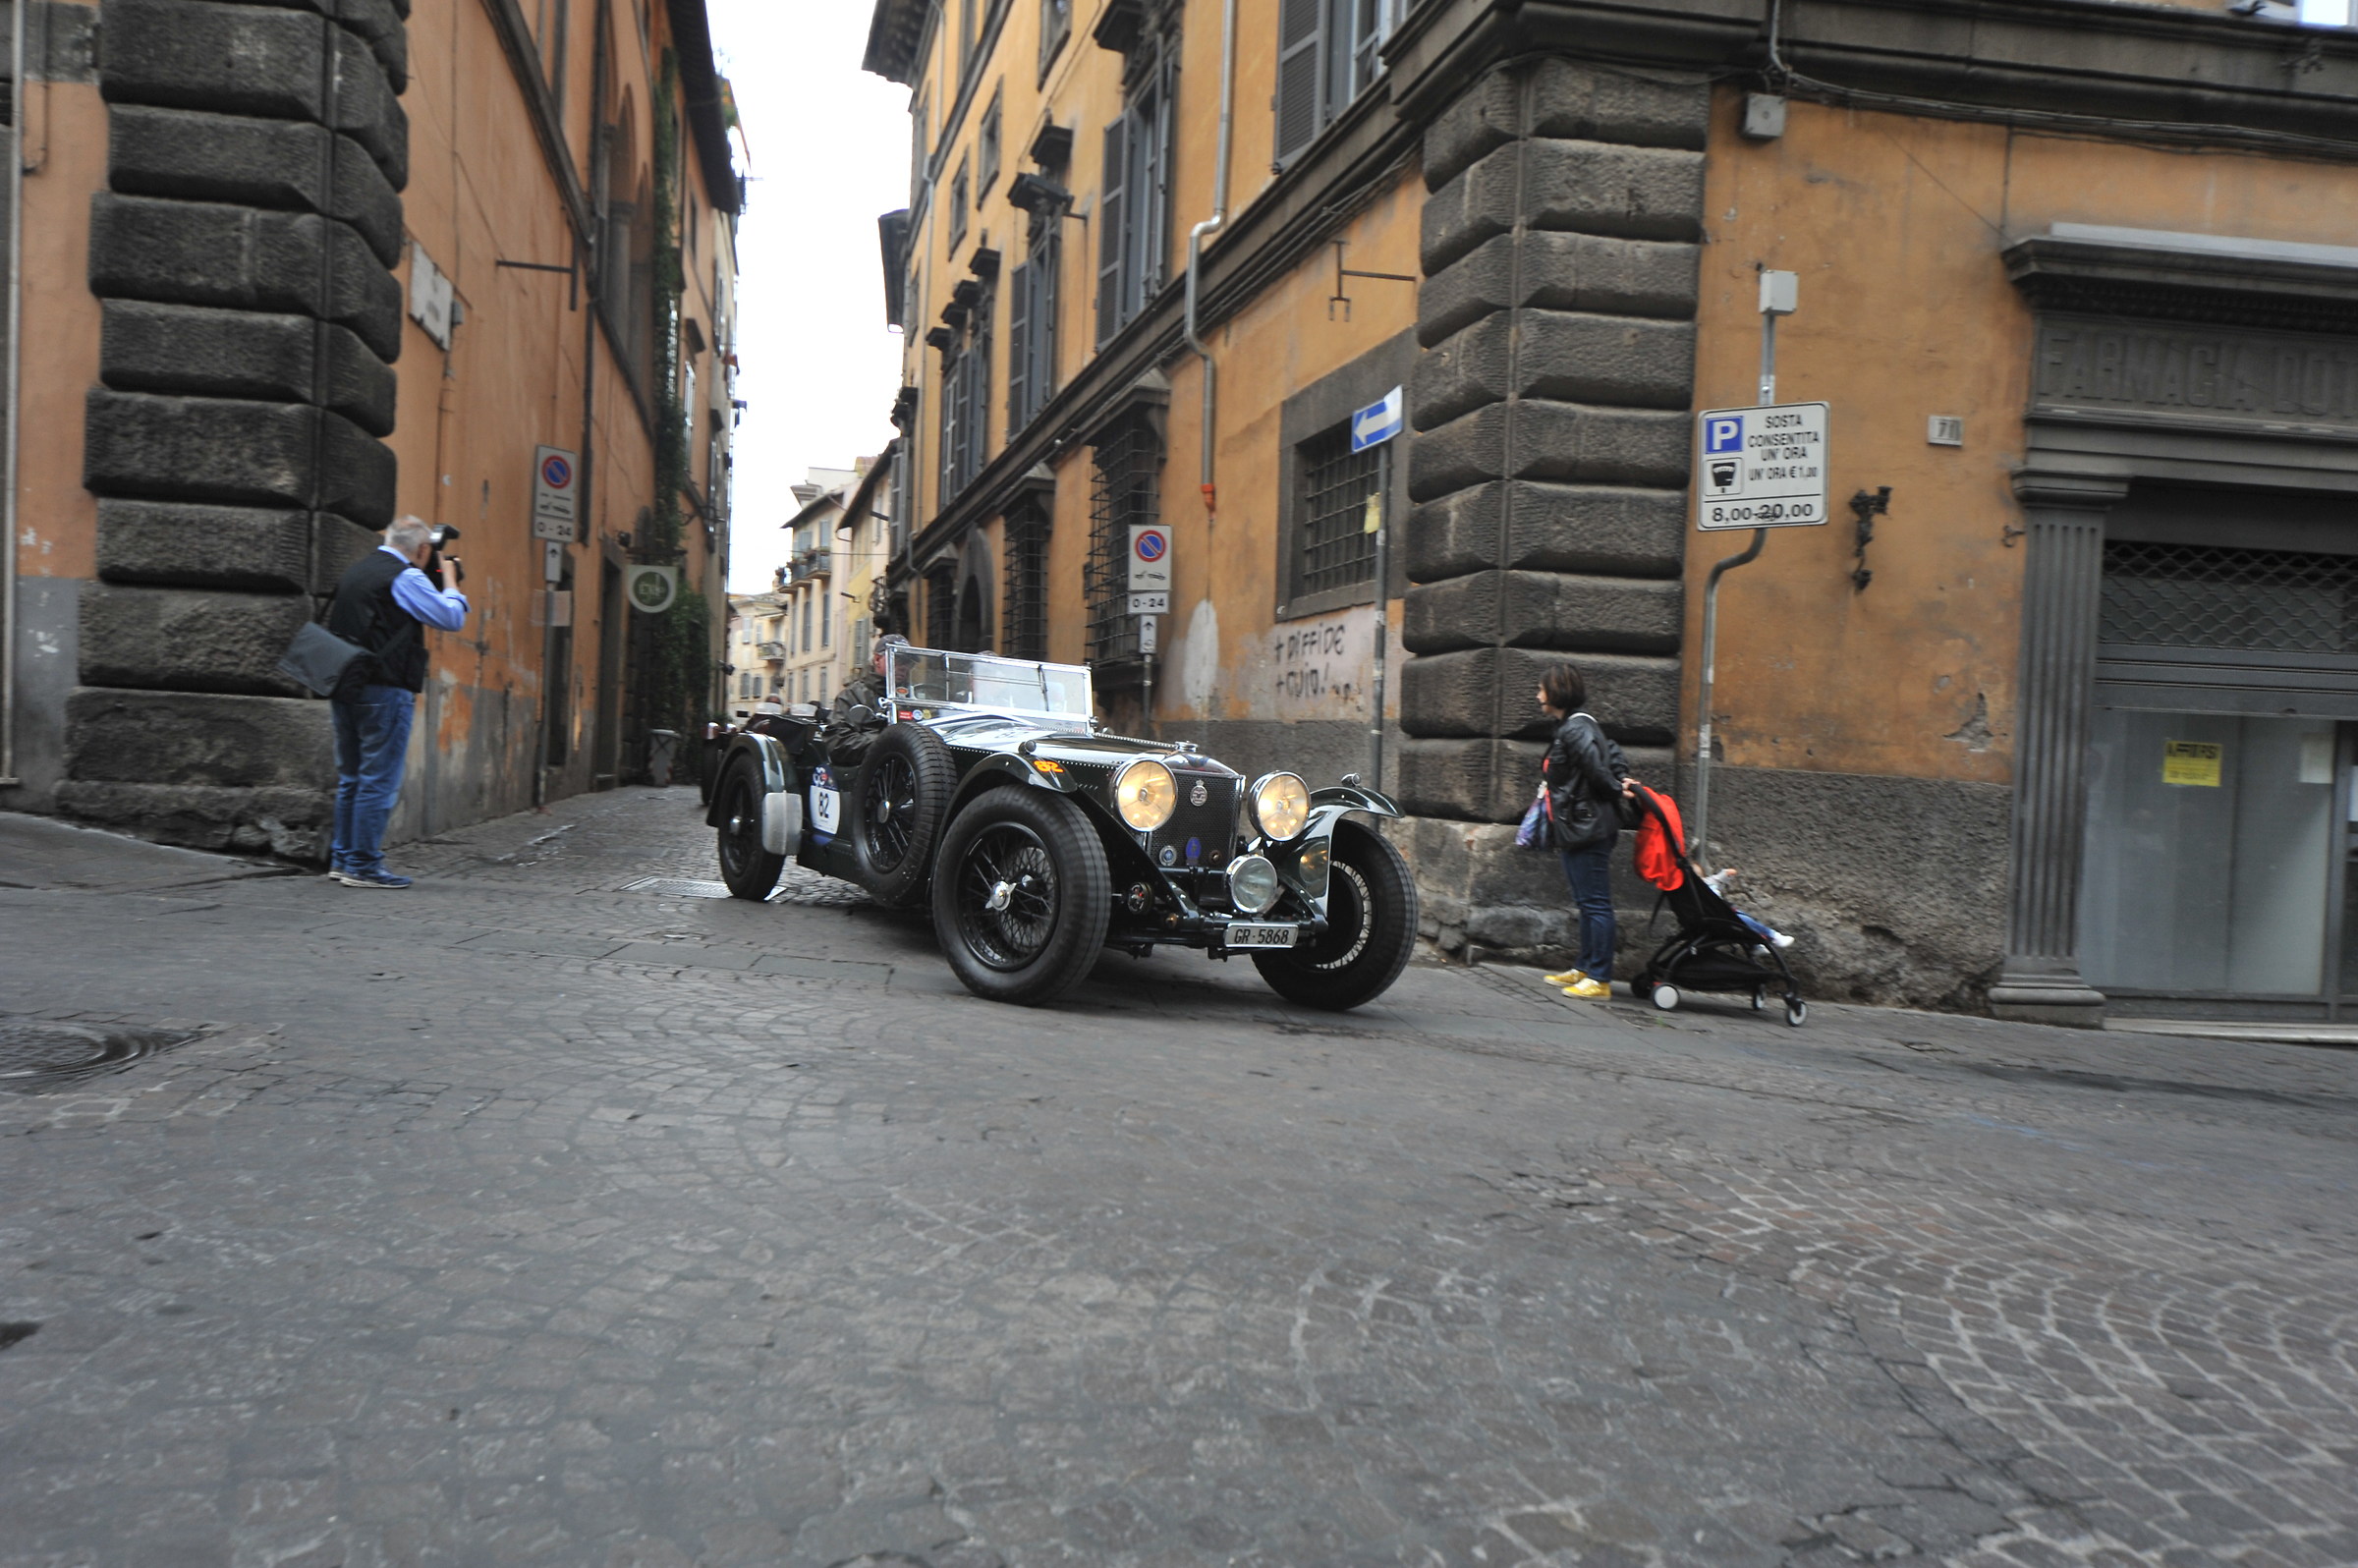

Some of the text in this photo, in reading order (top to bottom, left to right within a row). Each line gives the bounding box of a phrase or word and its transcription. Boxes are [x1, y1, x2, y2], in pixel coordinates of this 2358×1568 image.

[2037, 329, 2255, 412] FARMACIA
[1765, 415, 1802, 428] SOSTA
[1712, 420, 1738, 450] P
[1748, 431, 1819, 448] CONSENTITA
[1782, 447, 1807, 460] ORA
[1767, 467, 1786, 479] ORA
[1034, 760, 1065, 773] 82
[818, 791, 829, 819] 82
